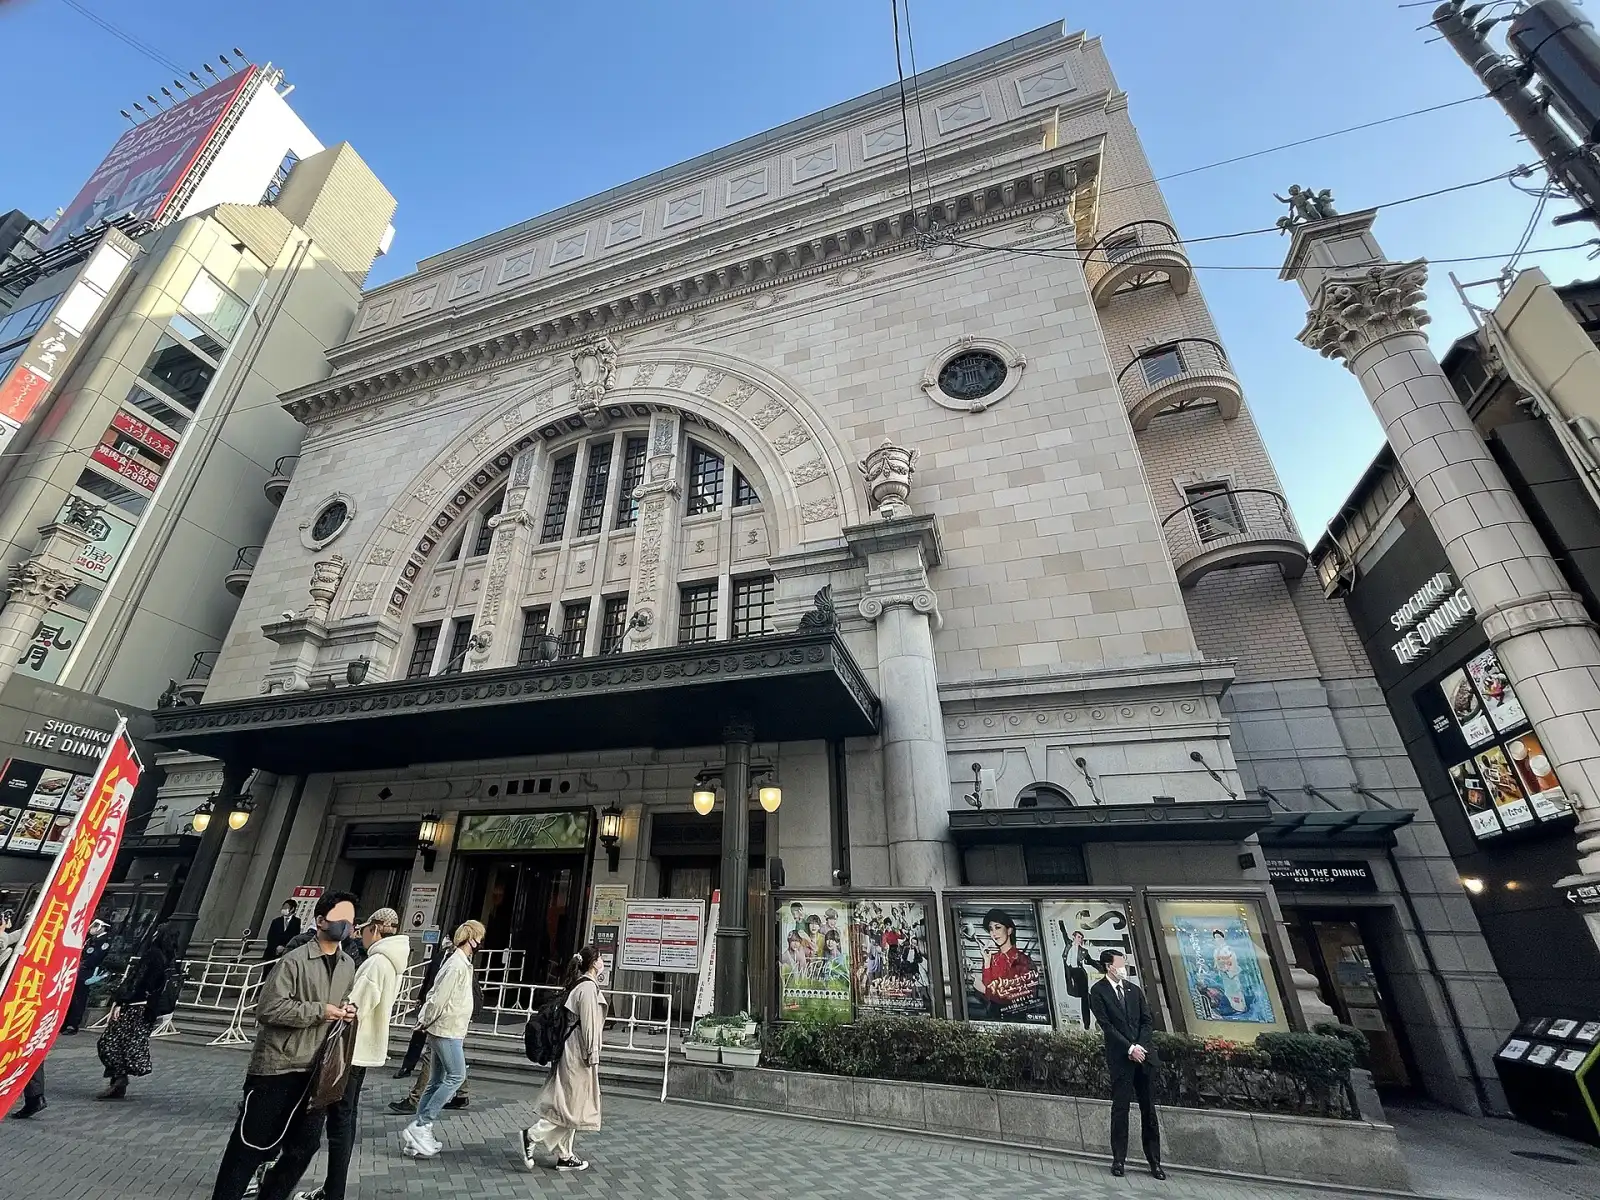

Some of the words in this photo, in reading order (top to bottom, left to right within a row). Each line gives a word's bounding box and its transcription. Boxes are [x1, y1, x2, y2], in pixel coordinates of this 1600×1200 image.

[98, 445, 159, 483] 焼肉食べ放題
[1391, 573, 1446, 631] SHOCHIKU
[1391, 631, 1422, 664] THE
[1416, 588, 1472, 645] DINING
[24, 729, 58, 748] THE
[60, 738, 107, 759] DININ
[45, 719, 112, 743] SHOCHIKU
[1311, 868, 1330, 877] THE
[1331, 868, 1367, 877] DINING
